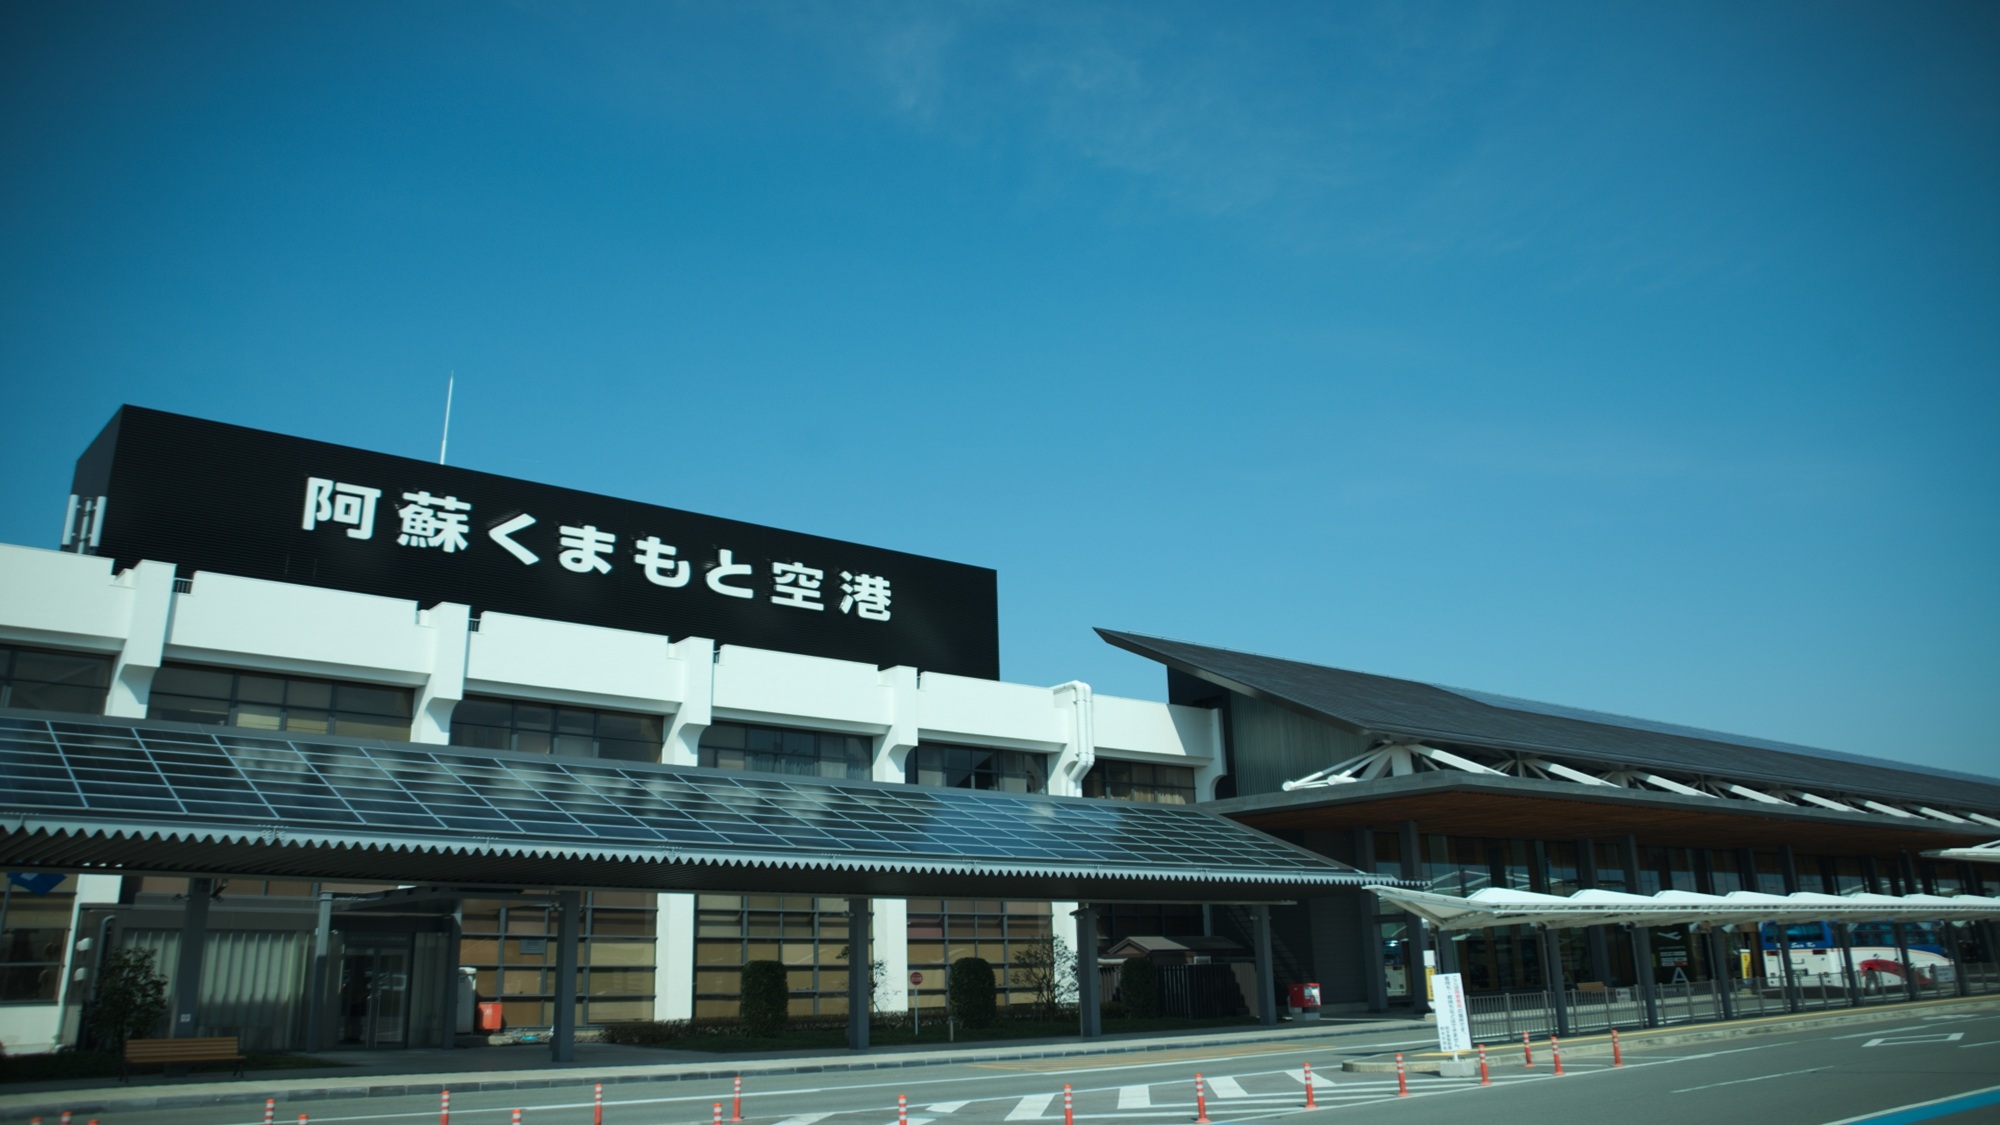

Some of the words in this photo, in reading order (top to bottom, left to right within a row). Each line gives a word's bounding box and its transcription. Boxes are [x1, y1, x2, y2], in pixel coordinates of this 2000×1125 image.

[302, 476, 892, 622] 阿蘇くまもと空港
